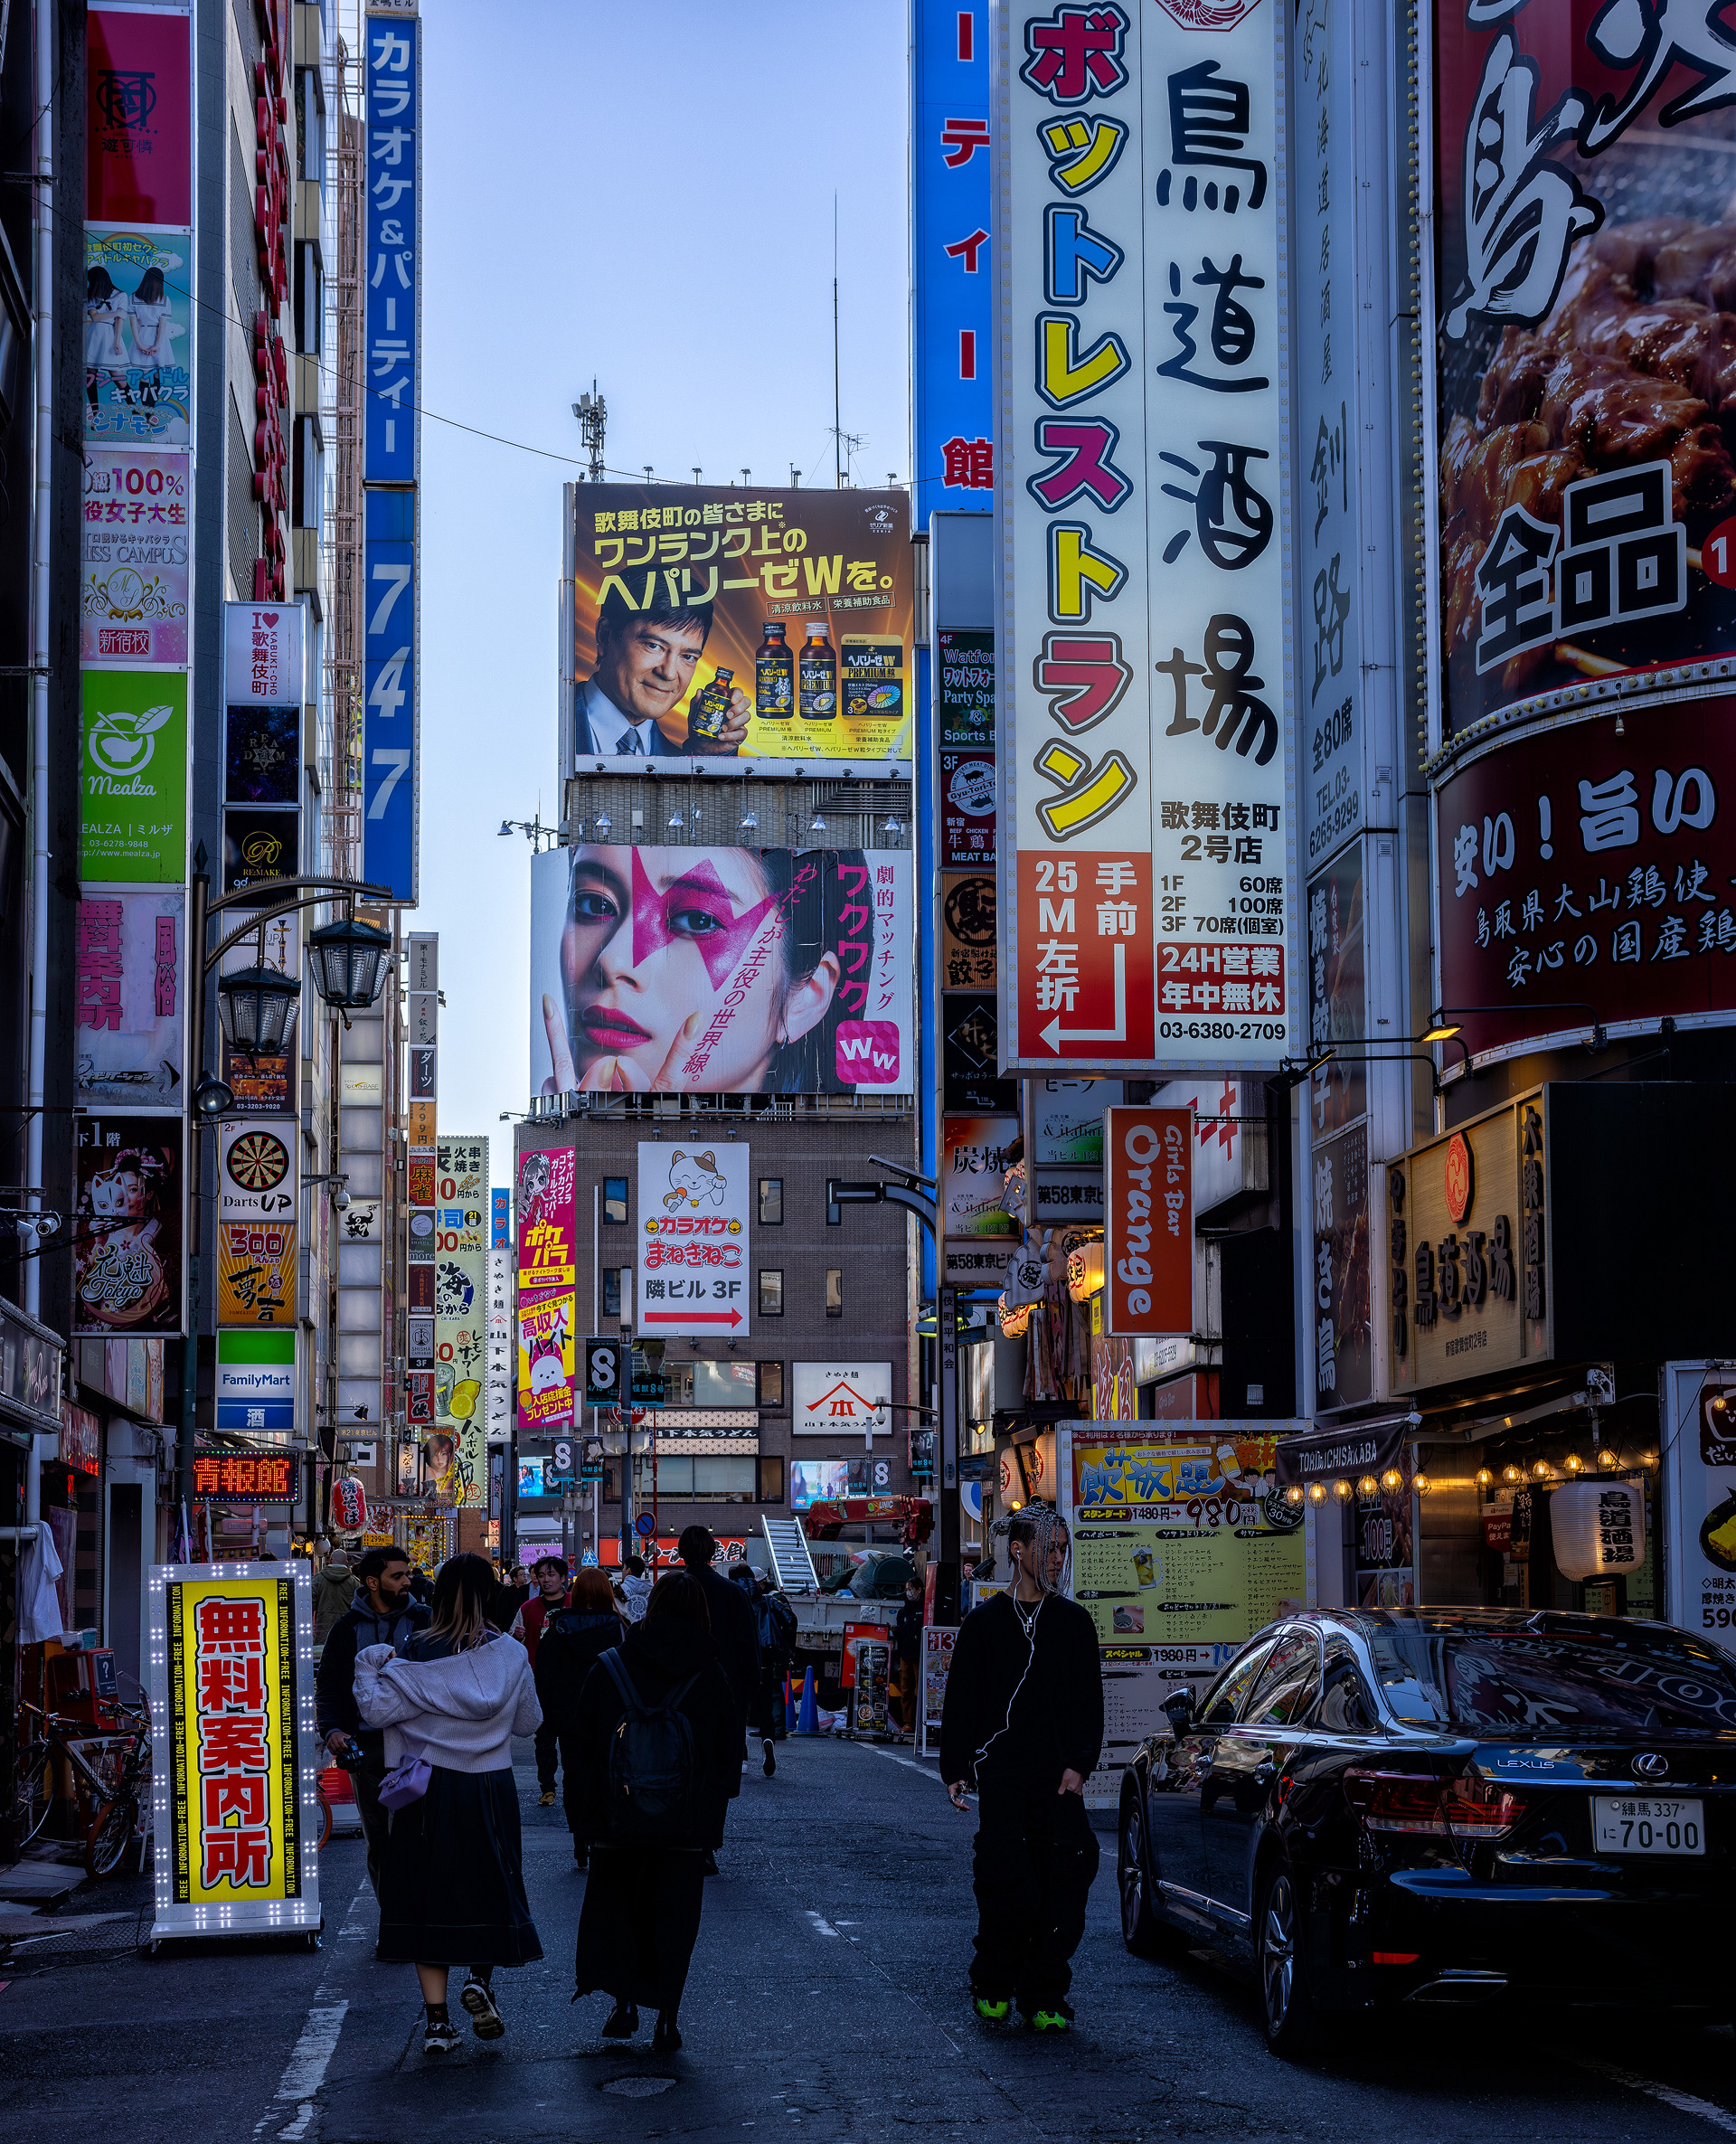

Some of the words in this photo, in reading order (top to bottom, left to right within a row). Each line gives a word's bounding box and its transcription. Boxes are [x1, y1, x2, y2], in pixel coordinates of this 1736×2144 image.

[372, 33, 412, 452] カラオケ&パーティー
[110, 385, 189, 403] キャバクラ
[1019, 3, 1138, 843] ボットレストラン
[594, 501, 784, 534] 歌舞伎町の皆さまに
[118, 535, 186, 563] CAMPUS
[594, 526, 807, 568] ワンランク上の
[1476, 459, 1688, 676] 全品
[595, 554, 893, 610] ヘパリーゼWを。
[771, 600, 823, 614] 清涼飲料水
[833, 595, 891, 609] 栄養補助食品
[99, 630, 149, 655] 新宿校
[939, 635, 953, 645] 4F
[251, 631, 269, 695] 歌舞伎町
[270, 631, 278, 695] KABUKI-CHO
[848, 654, 895, 666] ヘパリーゼW
[848, 667, 886, 678] PREMIUM
[801, 680, 835, 691] PREMIUM
[943, 690, 974, 708] Party
[781, 733, 812, 741] 清涼飲料水
[944, 730, 986, 742] Sports
[1313, 695, 1354, 775] 全80席
[943, 755, 959, 770] 3F
[88, 775, 157, 796] Mealza
[1316, 764, 1351, 817] TEL.03-
[946, 817, 965, 828] 新宿
[1161, 800, 1280, 832] 歌舞伎町
[1309, 789, 1359, 859] 6265-9299
[137, 824, 174, 835] ミルザ
[948, 835, 963, 850] 牛
[969, 835, 985, 850] 鶏
[90, 840, 148, 848] 03-6278-9848
[1180, 835, 1262, 864] 2号店
[951, 853, 980, 863] MEAT
[1161, 875, 1184, 892] 1F
[1239, 876, 1283, 894] 60席
[1095, 860, 1137, 937] 手前
[1161, 896, 1186, 911] 2F
[1228, 897, 1284, 915] 100席
[836, 864, 870, 1014] ワクワク
[876, 864, 895, 1012] 劇的マッチング
[1161, 916, 1186, 932] 3F
[1194, 916, 1284, 936] 70席(個室)
[681, 862, 818, 1083] わたしが主役の世界線。
[1160, 947, 1281, 977] 24H営業
[1161, 981, 1281, 1012] 年中無休
[1159, 1021, 1286, 1040] 03-6380-2709
[420, 1051, 433, 1088] ダーツ
[421, 1089, 431, 1097] 8F
[224, 1123, 236, 1132] 2F
[1048, 1149, 1080, 1161] 当ビル
[1165, 1124, 1184, 1184] Girls
[411, 1166, 434, 1201] 麻雀
[548, 1158, 560, 1219] ガールズバー
[556, 1154, 568, 1204] コンカフェ
[564, 1149, 575, 1204] キャバクラ
[223, 1195, 259, 1208] Darts
[261, 1194, 292, 1213] UP
[1165, 1188, 1185, 1237] Bar
[659, 1217, 728, 1235] カラオケ
[955, 1223, 982, 1233] 当ビル
[1118, 1124, 1161, 1316] Orange
[230, 1228, 285, 1257] 300
[645, 1239, 742, 1269] まねきねこ
[1315, 1157, 1337, 1392] 焼き鳥
[1390, 1168, 1407, 1356] やきとり
[82, 1278, 142, 1305] Tokyo
[493, 1258, 505, 1309] さぬき麺
[646, 1280, 706, 1299] 隣ビル
[712, 1280, 741, 1299] 3F
[536, 1295, 574, 1312] 今すぐ見つかる
[521, 1308, 569, 1339] 高収入
[528, 1330, 573, 1359] バイト
[222, 1374, 290, 1387] FamilyMart
[489, 1331, 508, 1436] 山下本気うどん
[825, 1371, 859, 1379] さぬき麺
[526, 1397, 573, 1421] プレゼント中
[532, 1385, 571, 1408] 入店応援金
[246, 1408, 265, 1428] 酒
[1080, 1447, 1226, 1506] 飲み放題
[879, 1500, 894, 1509] UNIC
[1082, 1508, 1127, 1520] スタンダード
[1132, 1506, 1171, 1521] 1480円
[1186, 1497, 1241, 1529] 980
[279, 1582, 288, 1601] FREE
[1105, 1649, 1144, 1658] スペシャル
[1154, 1648, 1197, 1663] 1980円
[196, 1598, 269, 1887] 無料案内所
[1496, 1760, 1555, 1770] LEXUS
[1621, 1801, 1652, 1818] 練馬
[1654, 1802, 1680, 1818] 337
[1603, 1827, 1617, 1840] に
[1619, 1820, 1699, 1850] 70-00
[180, 1879, 188, 1899] FREE
